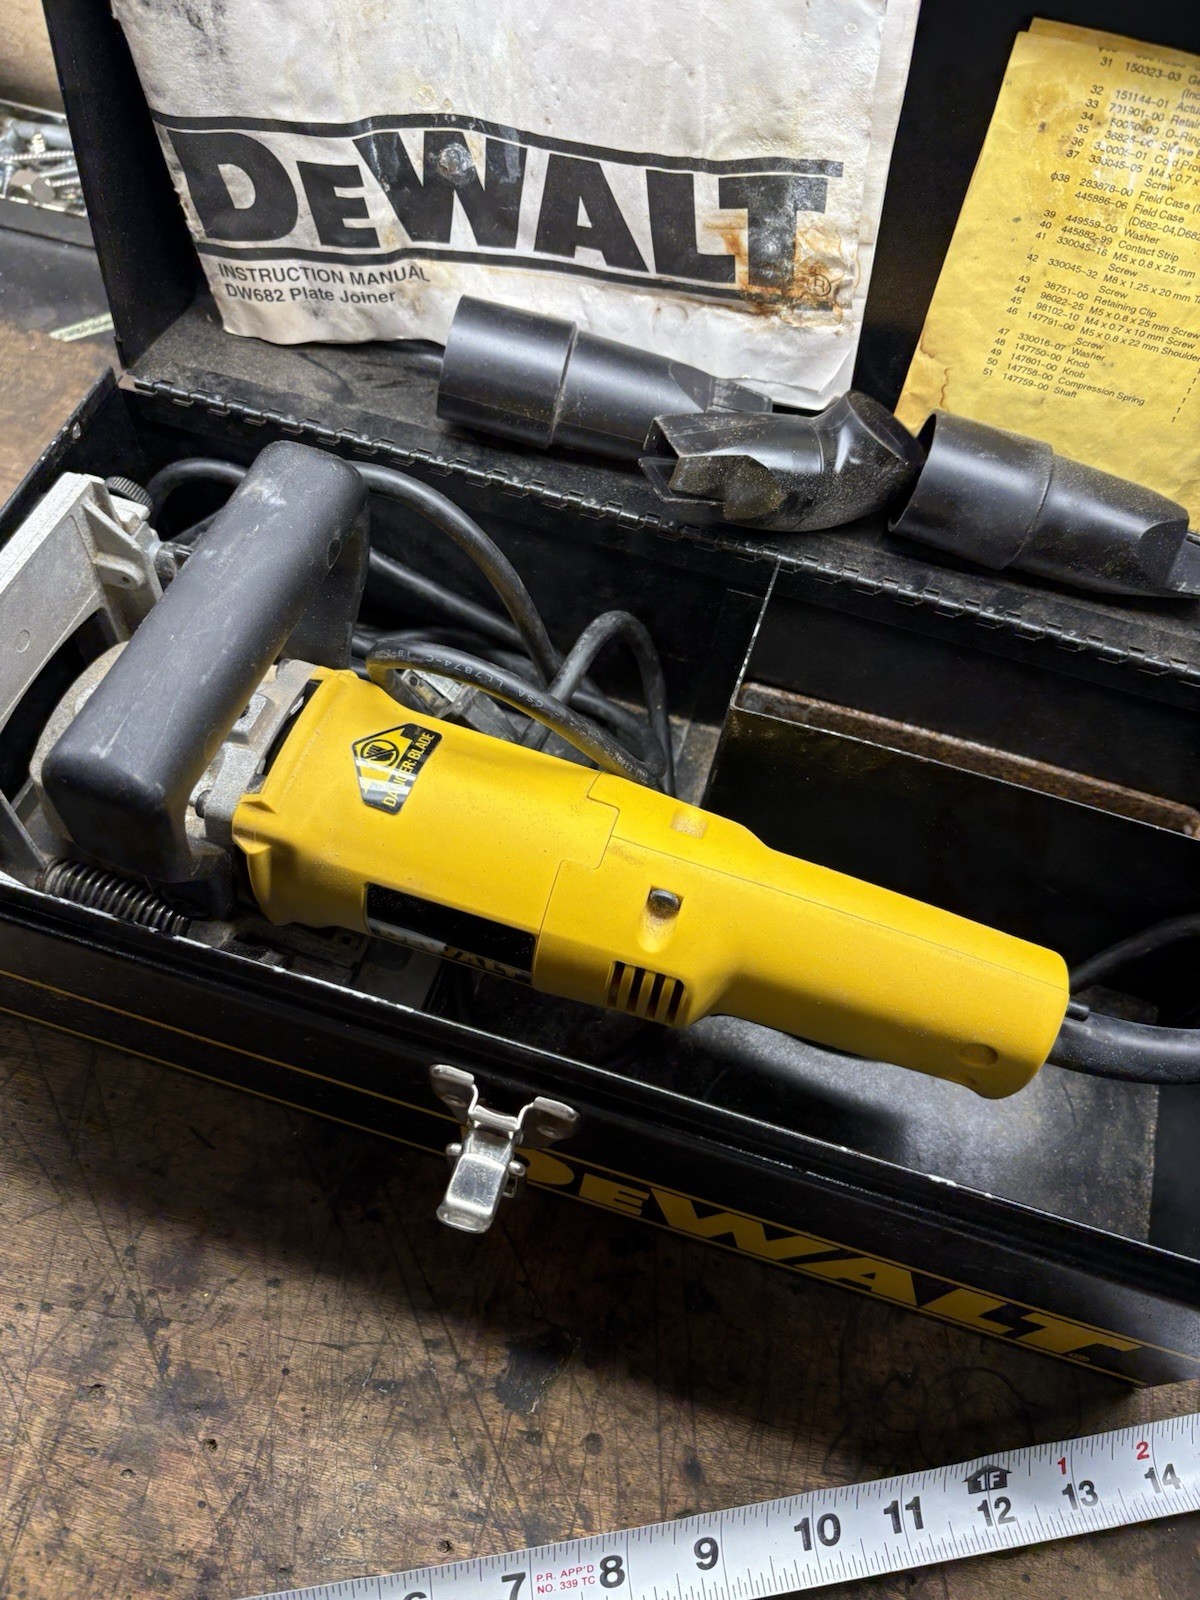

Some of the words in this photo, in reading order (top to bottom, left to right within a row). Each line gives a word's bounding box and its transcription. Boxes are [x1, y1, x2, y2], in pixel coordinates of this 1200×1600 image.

[1100, 57, 1113, 67] 31
[1125, 62, 1182, 82] 150323-03
[1085, 99, 1099, 109] 33
[1090, 84, 1104, 95] 32
[1116, 90, 1169, 109] 151144-01
[1076, 124, 1089, 134] 35
[1081, 111, 1094, 121] 34
[1066, 149, 1080, 159] 37
[1148, 167, 1164, 178] M4
[1175, 173, 1192, 184] 0.7
[1071, 136, 1085, 147] 36
[1093, 142, 1148, 160] 30005-01
[1154, 155, 1182, 167] Cod
[1079, 178, 1134, 197] 283878-00
[1138, 190, 1164, 204] Field
[1164, 196, 1190, 210] Case
[1144, 178, 1176, 193] Screw
[1075, 190, 1129, 210] 445886-06
[1133, 203, 1158, 218] Field
[1158, 209, 1185, 224] Case
[1039, 220, 1052, 229] 40
[1061, 225, 1113, 245] 445882-99
[1118, 240, 1155, 257] Contact
[1156, 250, 1180, 263] Strip
[1043, 209, 1056, 219] 39
[1065, 214, 1118, 234] 449559-00
[1124, 227, 1160, 245] Washer
[1035, 231, 1046, 240] 41
[1056, 236, 1108, 257] 330045-16
[1112, 251, 1128, 262] M5
[1137, 258, 1154, 269] 0.8
[1162, 264, 1176, 274] 25
[1177, 269, 1196, 280] mm
[1108, 263, 1139, 277] Screw
[218, 263, 345, 284] INSTRUCTION
[350, 266, 431, 286] MANUAL
[1026, 253, 1039, 263] 42
[1047, 258, 1099, 279] 330045-32
[1103, 273, 1119, 285] M8
[1129, 281, 1149, 292] 1.25
[1158, 288, 1172, 298] 20
[1172, 292, 1192, 303] mm
[225, 283, 285, 303] DW682
[290, 287, 334, 301] Plate
[340, 290, 396, 304] Joiner
[1018, 275, 1031, 284] 43
[1044, 280, 1089, 301] 38751-00
[1093, 295, 1137, 315] Retaining
[1138, 307, 1158, 319] Clip
[1098, 285, 1129, 300] Screw
[1010, 296, 1023, 305] 45
[1036, 302, 1080, 322] 98102-10
[1084, 316, 1100, 327] M4
[1108, 323, 1124, 333] 0.7
[1134, 329, 1147, 339] 10
[1146, 334, 1166, 345] mm
[1166, 336, 1196, 351] Screw
[1014, 285, 1026, 294] 44
[1089, 305, 1105, 317] M5
[1113, 312, 1129, 323] 0.8
[1137, 318, 1151, 328] 25
[1151, 323, 1171, 335] mm
[1171, 326, 1200, 340] Screw
[998, 327, 1010, 336] 47
[1017, 332, 1067, 352] 330016-07
[1071, 347, 1106, 363] Washer
[1006, 306, 1018, 316] 46
[1027, 311, 1076, 332] 147791-00
[1079, 326, 1095, 338] M5
[1103, 333, 1119, 344] 0.8
[1126, 339, 1141, 349] 22
[1141, 344, 1159, 354] mm
[1075, 337, 1105, 351] Screw
[990, 347, 1002, 357] 49
[1010, 352, 1058, 372] 147801-00
[1062, 366, 1086, 380] Knob
[994, 337, 1006, 347] 48
[1014, 343, 1062, 362] 147750-00
[1066, 356, 1090, 370] Knob
[982, 367, 993, 377] 51
[1002, 372, 1050, 392] 147759-00
[1053, 386, 1078, 399] Shaft
[986, 357, 999, 367] 50
[1006, 362, 1054, 382] 147758-00
[1058, 377, 1116, 398] Compression
[1116, 391, 1146, 407] Spring
[518, 688, 544, 709] CSA
[407, 731, 435, 762] BLADE
[1057, 1457, 1067, 1475] 1
[1136, 1441, 1150, 1461] 2
[501, 1572, 526, 1600] 7
[599, 1555, 626, 1588] 8
[693, 1537, 719, 1570] 9
[793, 1512, 842, 1552] 10
[883, 1496, 924, 1534] 11
[977, 1496, 1016, 1527] 12
[1062, 1480, 1099, 1511] 13
[1144, 1463, 1182, 1494] 14
[536, 1573, 557, 1583] P.R.
[560, 1564, 595, 1579] APP'D
[537, 1583, 557, 1594] NO.
[559, 1579, 578, 1591] 339
[581, 1575, 596, 1586] TC
